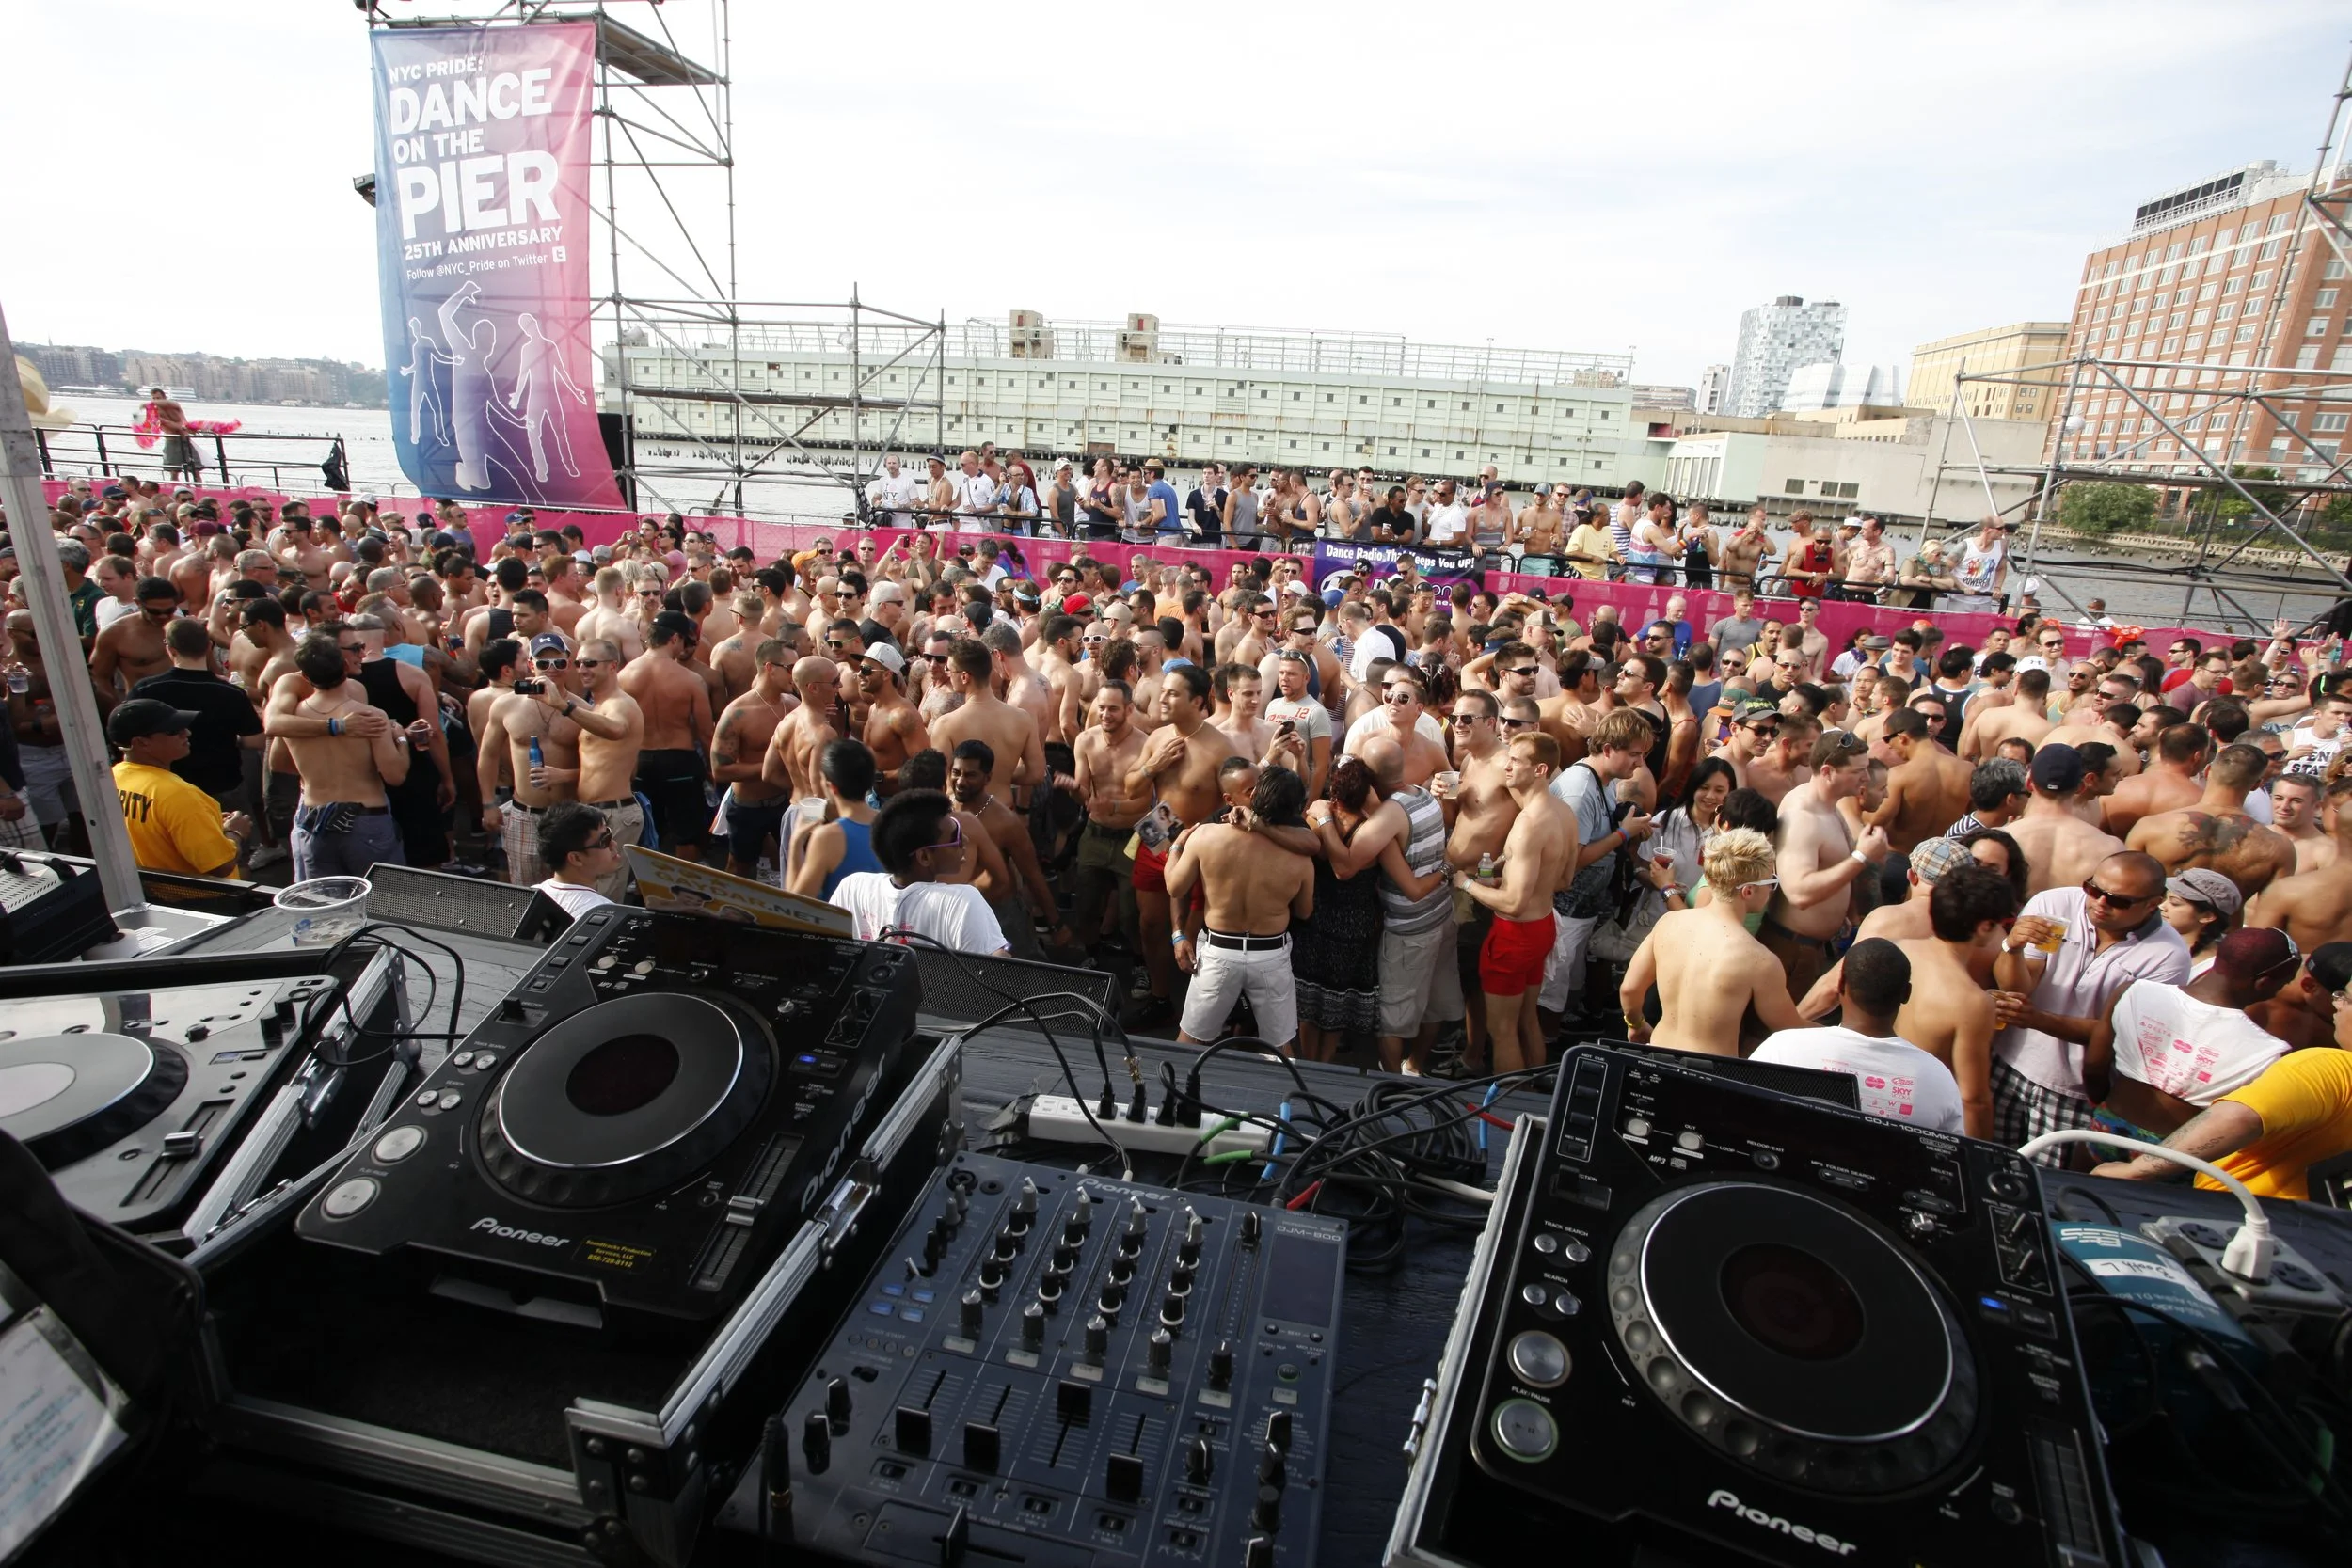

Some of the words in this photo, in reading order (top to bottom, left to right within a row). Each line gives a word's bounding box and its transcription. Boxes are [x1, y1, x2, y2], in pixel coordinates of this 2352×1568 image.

[389, 64, 421, 85] NYC
[426, 55, 484, 78] PRIDE:
[389, 68, 552, 135] DANCE
[394, 136, 426, 164] ON
[433, 128, 485, 158] THE
[397, 150, 561, 240] PIER
[405, 241, 442, 260] 25TH
[448, 226, 563, 254] ANNIVERSARY
[406, 267, 434, 280] Follow
[436, 257, 495, 276] @NYC_Pride
[498, 259, 510, 269] on
[512, 253, 548, 267] Twitter
[883, 491, 898, 500] NY
[1327, 544, 1354, 560] Dance
[1356, 546, 1383, 562] Radio
[1386, 548, 1406, 562] Tha
[1438, 557, 1455, 568] You
[1457, 557, 1475, 569] UP!
[1294, 706, 1310, 720] 12
[1864, 1116, 1960, 1144] CDJ-1000MK3
[1648, 1154, 1667, 1165] MP3
[1077, 1178, 1171, 1201] Pioneer
[470, 1217, 569, 1247] Pioneer
[1277, 1226, 1342, 1242] DJM-800
[1544, 1219, 1564, 1231] TRACK
[1565, 1225, 1589, 1237] SEARCH
[1543, 1272, 1568, 1285] SEARCH
[1621, 1397, 1637, 1409] REV
[1707, 1489, 1858, 1557] Pioneer
